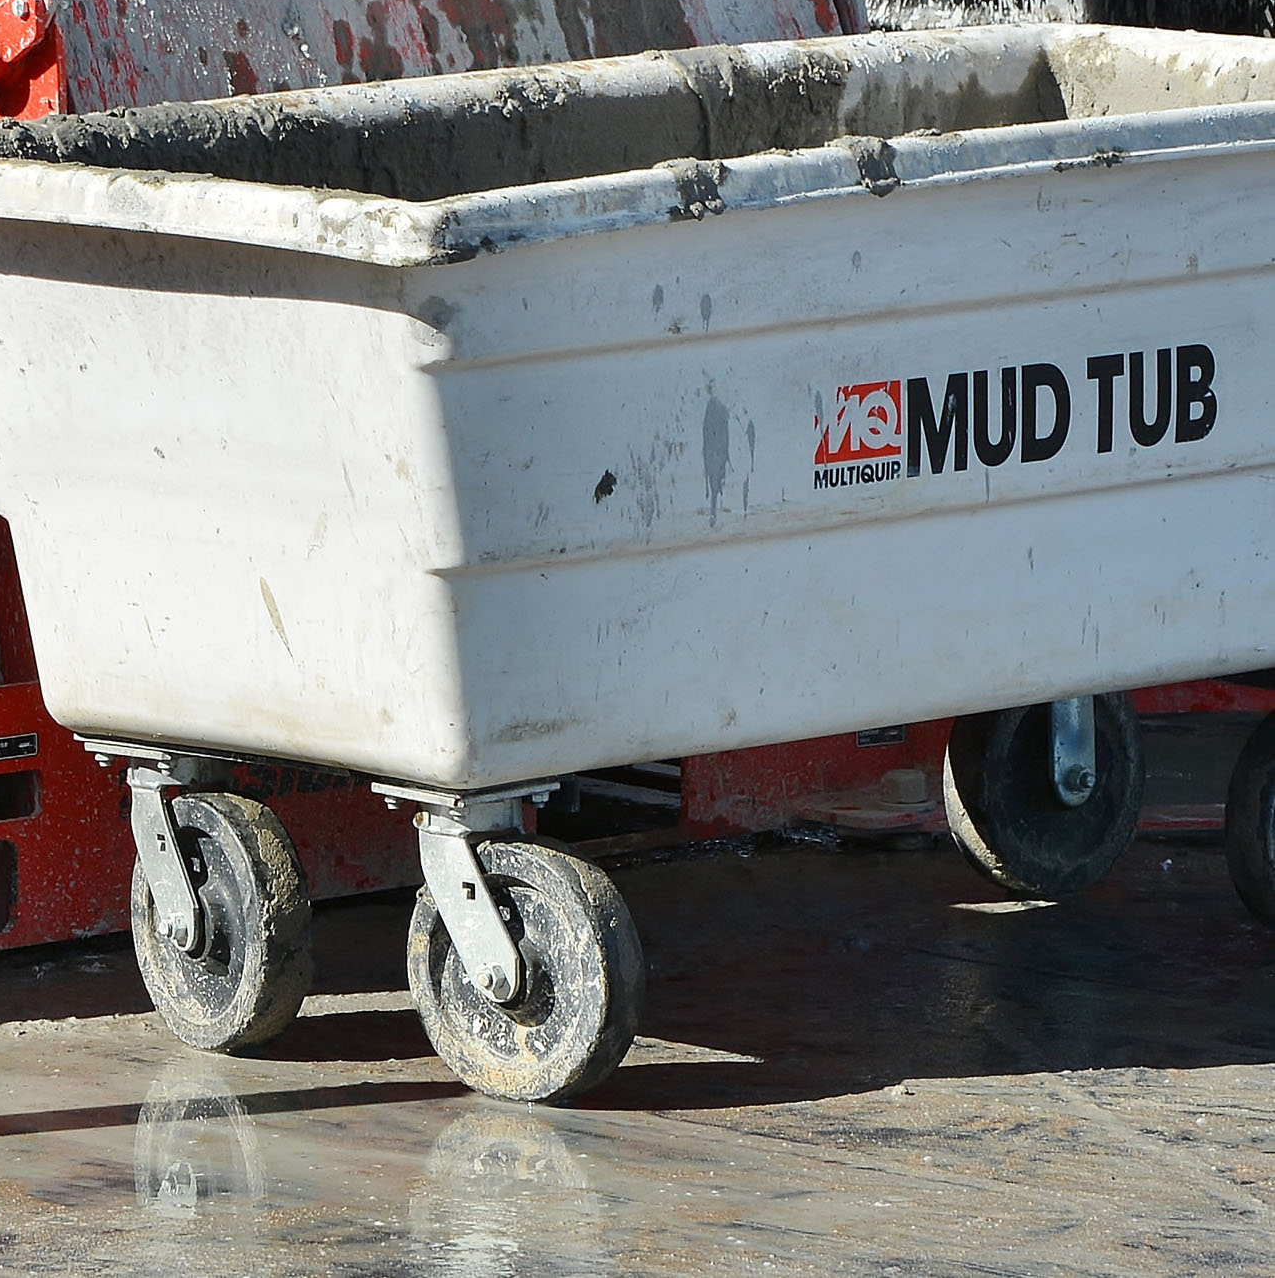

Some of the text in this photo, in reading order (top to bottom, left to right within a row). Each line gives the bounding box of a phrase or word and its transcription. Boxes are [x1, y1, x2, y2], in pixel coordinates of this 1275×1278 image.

[906, 343, 1218, 479] MUD TUB
[813, 460, 901, 491] MULTIQUIP
